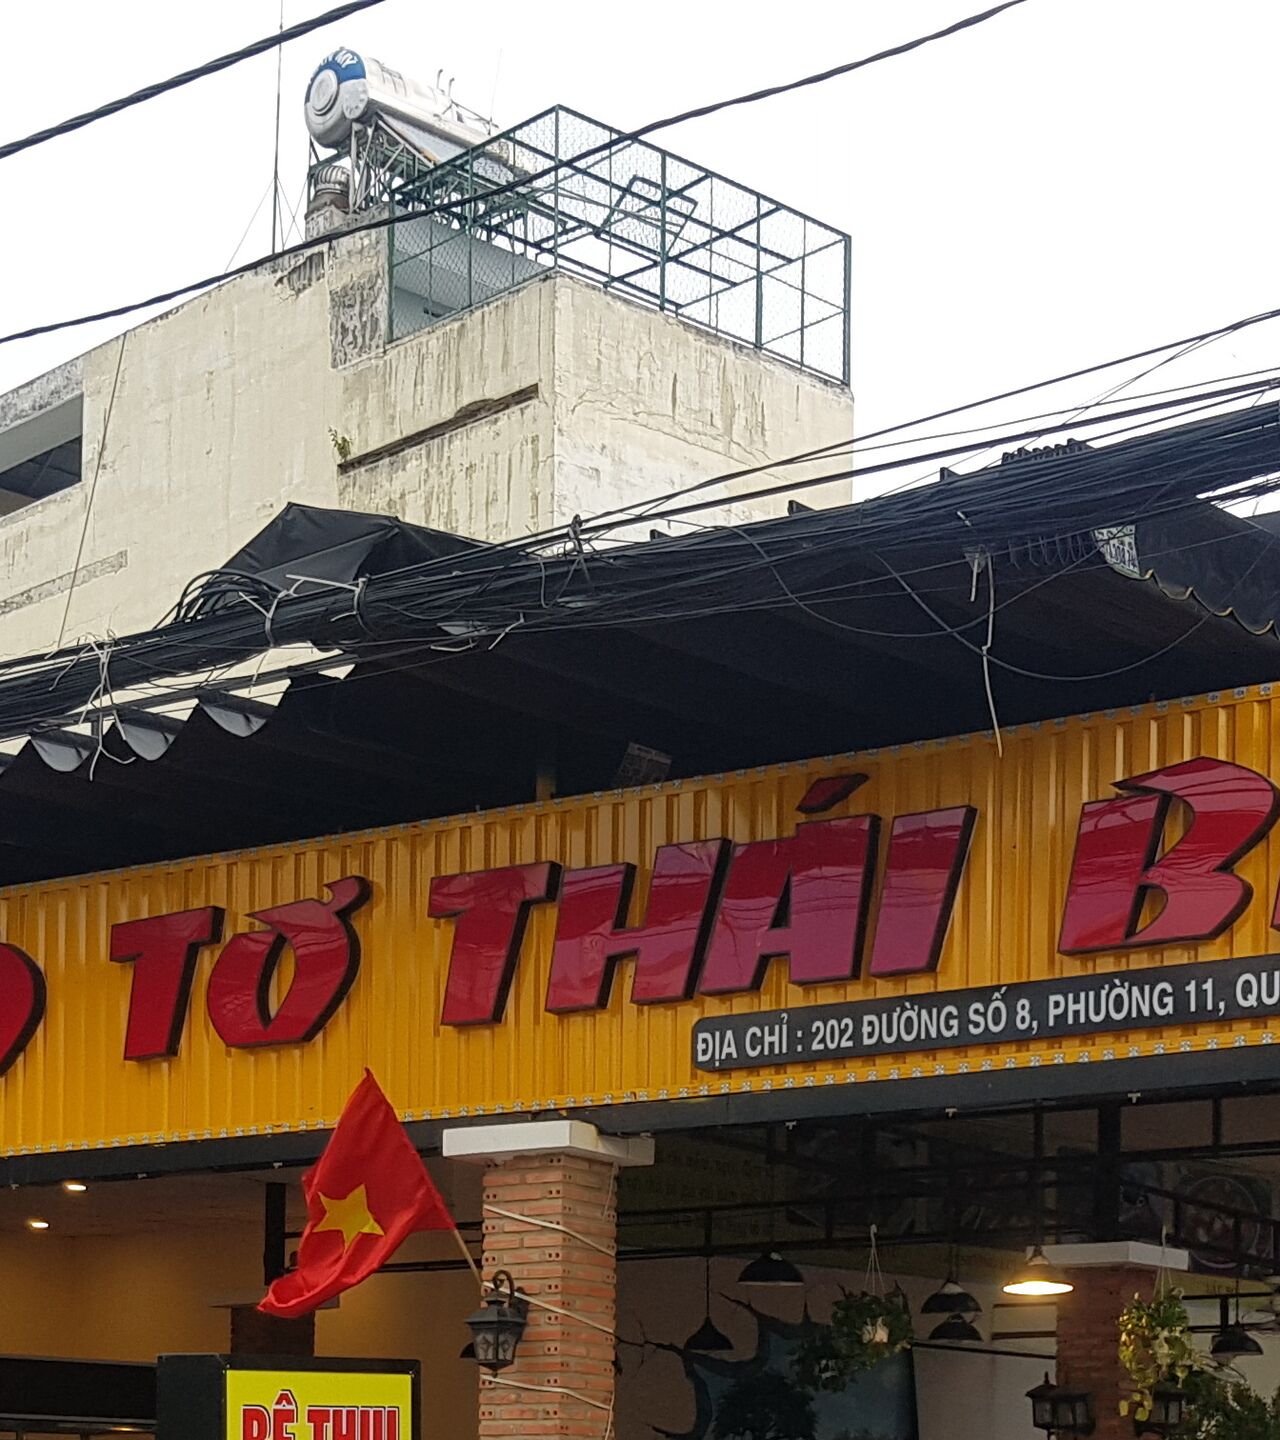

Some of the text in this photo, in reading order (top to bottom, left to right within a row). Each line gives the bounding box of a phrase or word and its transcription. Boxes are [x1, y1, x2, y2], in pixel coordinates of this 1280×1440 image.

[110, 875, 372, 1061] TƠ
[427, 773, 978, 1026] THÁI
[697, 1030, 738, 1068] ĐỊA
[745, 1011, 788, 1056] CHỈ
[811, 1018, 854, 1051] 202
[862, 1002, 959, 1046] ĐƯỜNG
[968, 986, 1009, 1035] SỐ
[1016, 998, 1039, 1035] 8,
[1047, 979, 1175, 1026] PHƯỜNG
[1184, 980, 1225, 1016] 11,
